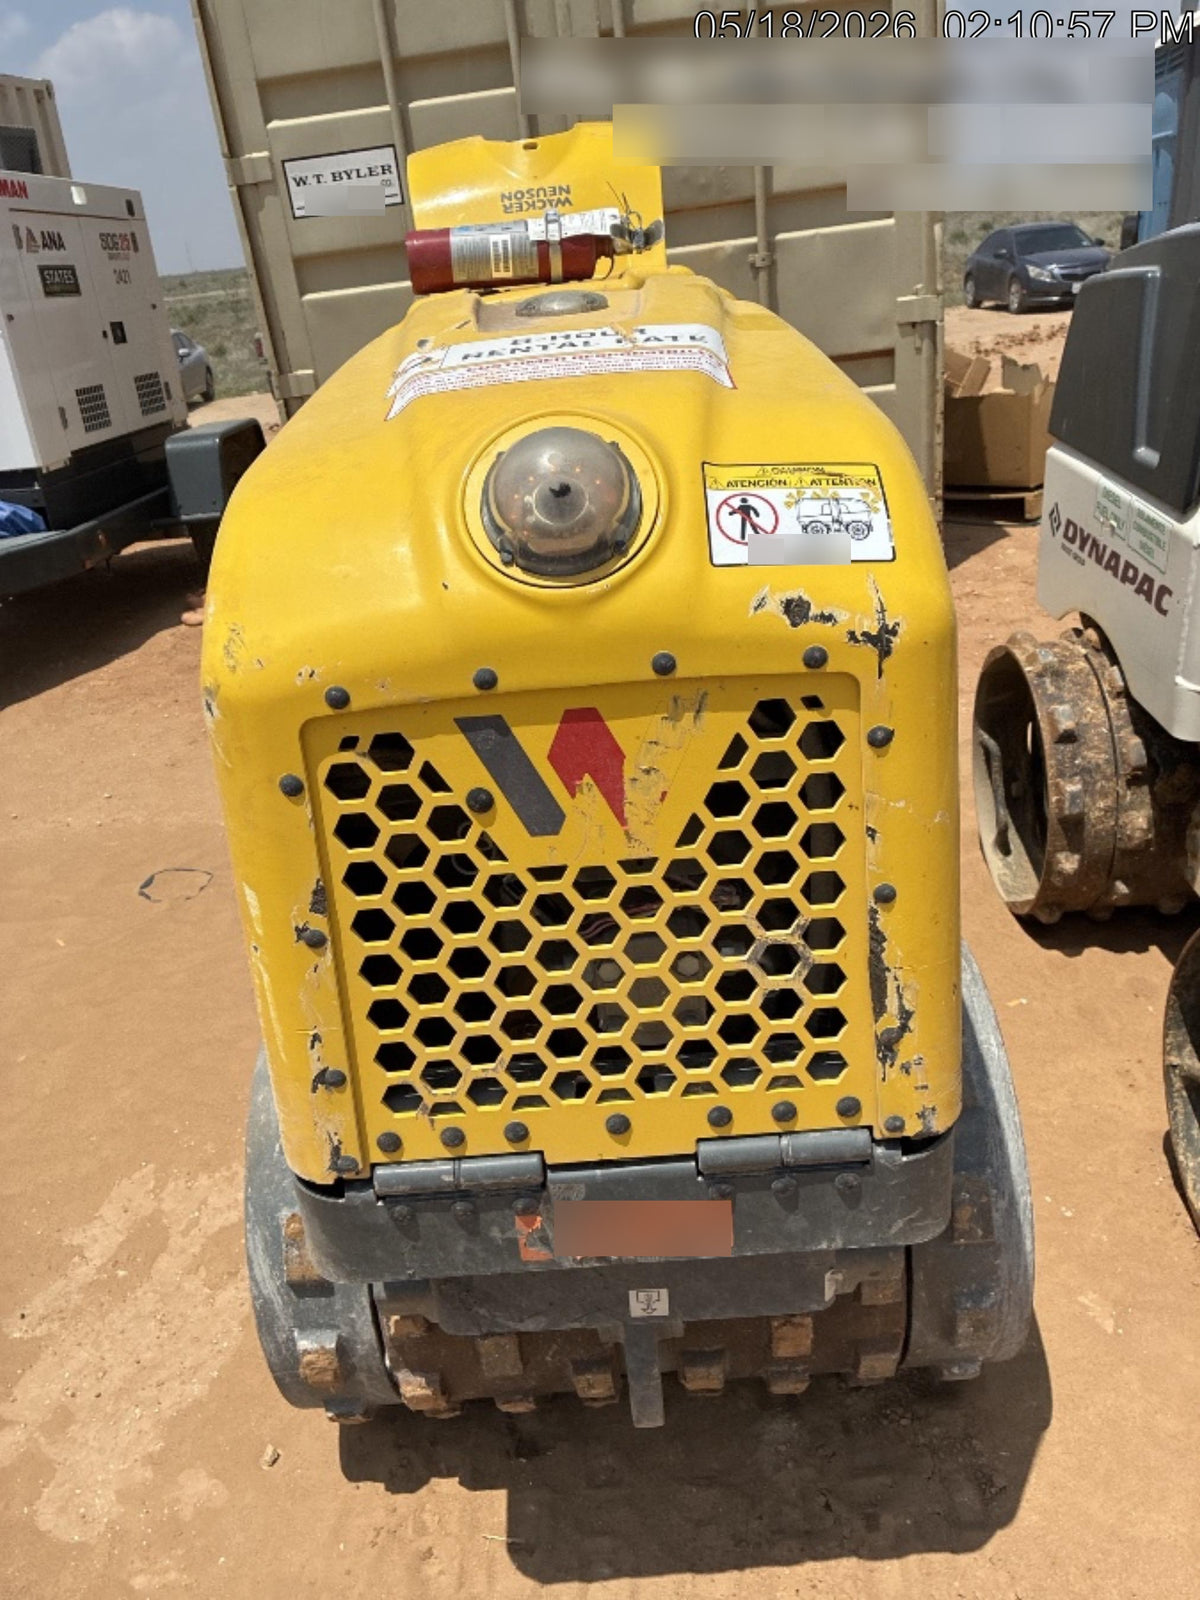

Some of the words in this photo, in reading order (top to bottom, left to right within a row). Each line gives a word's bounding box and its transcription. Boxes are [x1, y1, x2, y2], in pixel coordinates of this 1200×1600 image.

[330, 163, 394, 183] BYLER
[500, 184, 571, 203] NEUSON
[503, 197, 574, 215] WACKER
[40, 230, 67, 251] ANA
[43, 268, 77, 285] STATES
[726, 476, 787, 488] ATENCIÓN
[809, 477, 877, 488] ATTENTION
[1062, 517, 1174, 618] DYNAPAC
